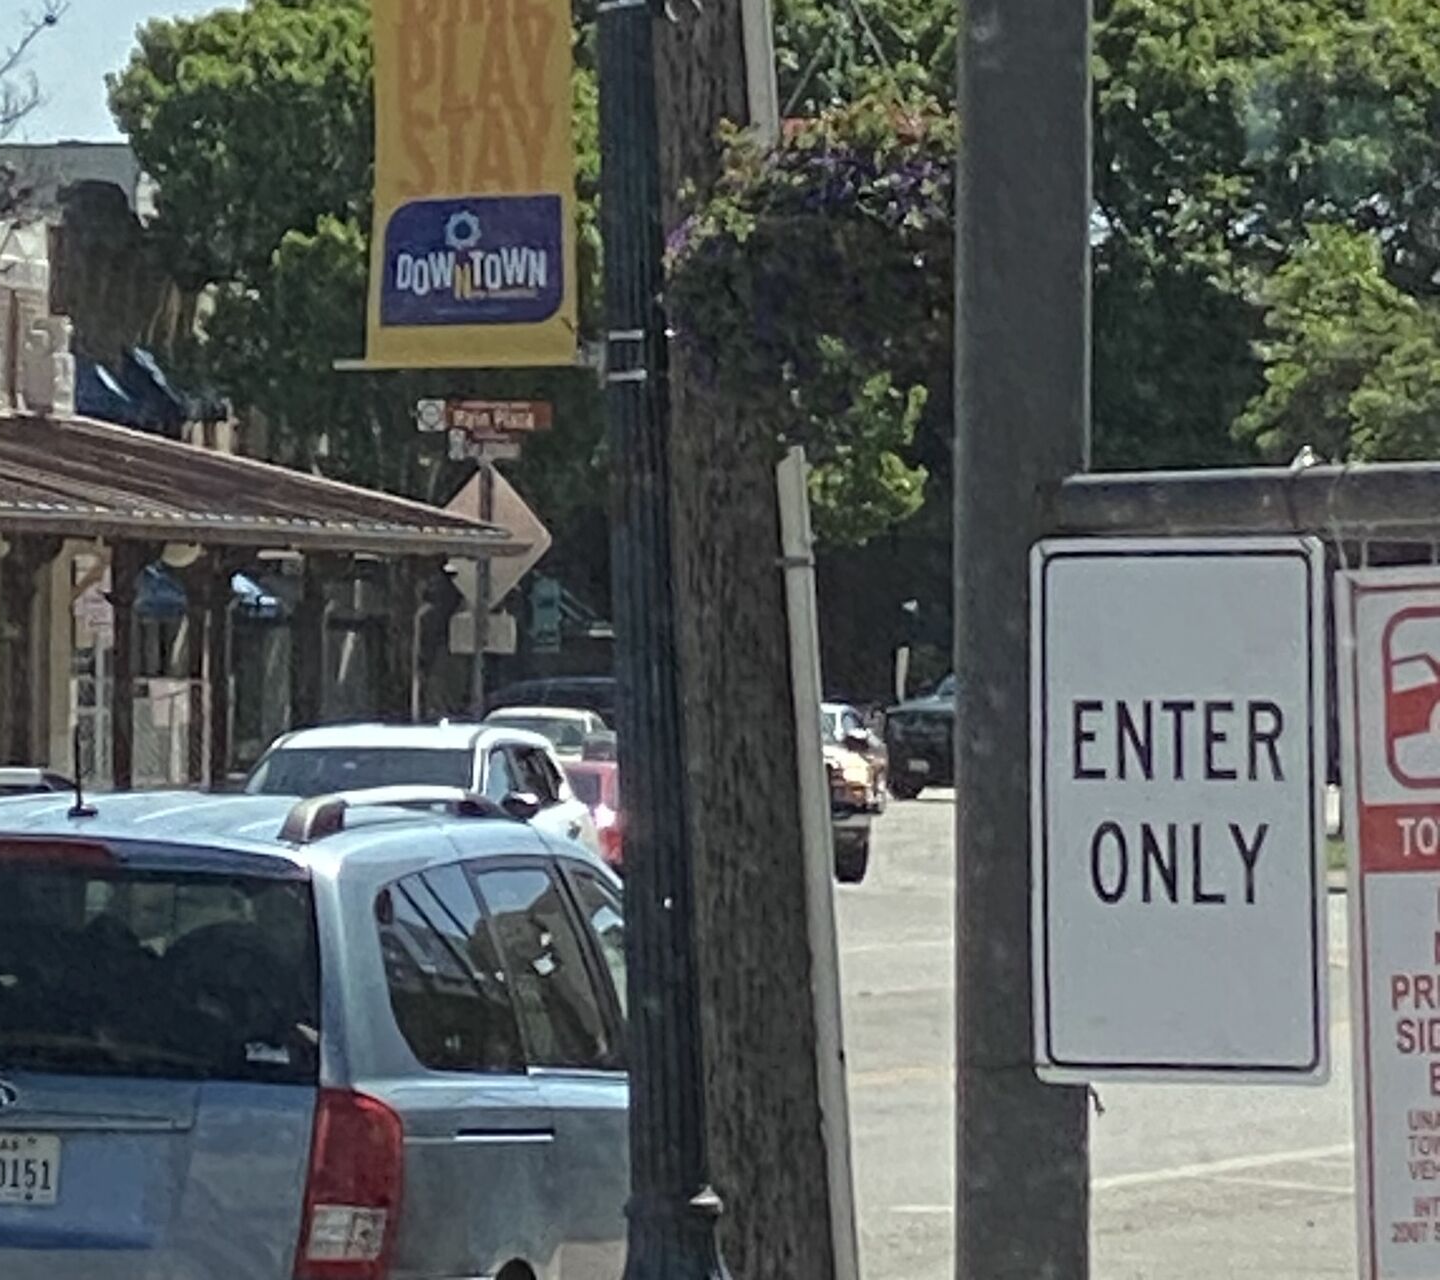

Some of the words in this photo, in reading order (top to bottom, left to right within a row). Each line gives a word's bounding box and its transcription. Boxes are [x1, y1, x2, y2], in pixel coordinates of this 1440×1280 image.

[396, 246, 548, 301] DOWNTOWN
[1072, 699, 1285, 781] ENTER
[1090, 820, 1270, 905] ONLY
[1396, 817, 1440, 856] TO
